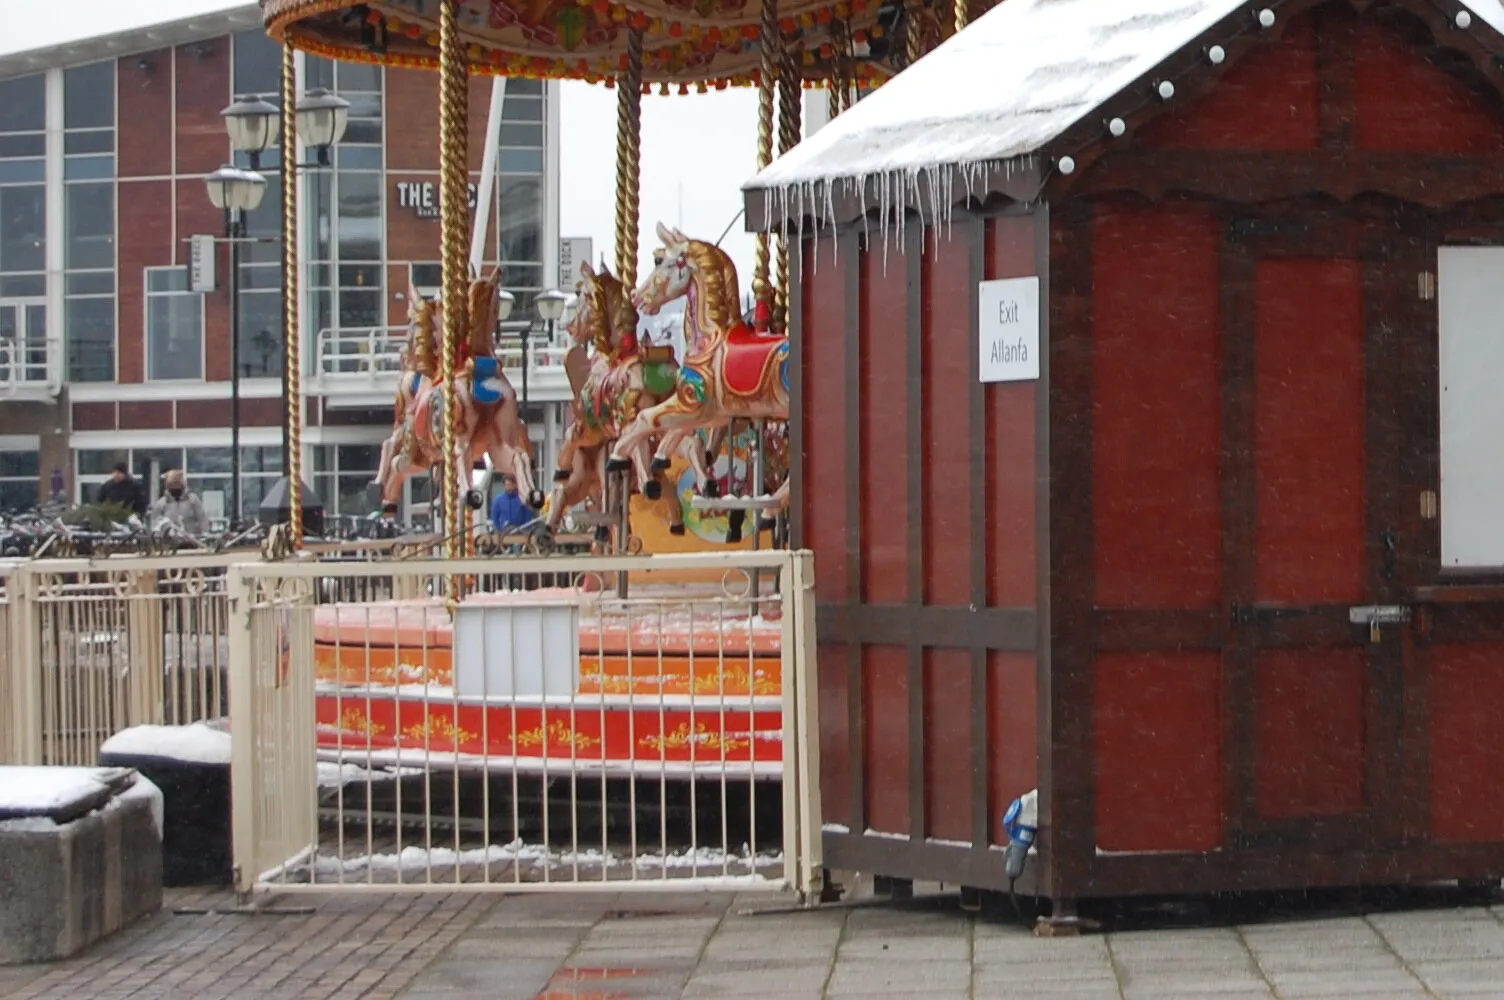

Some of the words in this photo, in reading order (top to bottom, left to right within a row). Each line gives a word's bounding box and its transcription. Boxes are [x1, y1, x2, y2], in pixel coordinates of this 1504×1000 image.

[396, 181, 434, 208] THE
[999, 299, 1020, 325] Exit
[990, 336, 1029, 364] Allanfa
